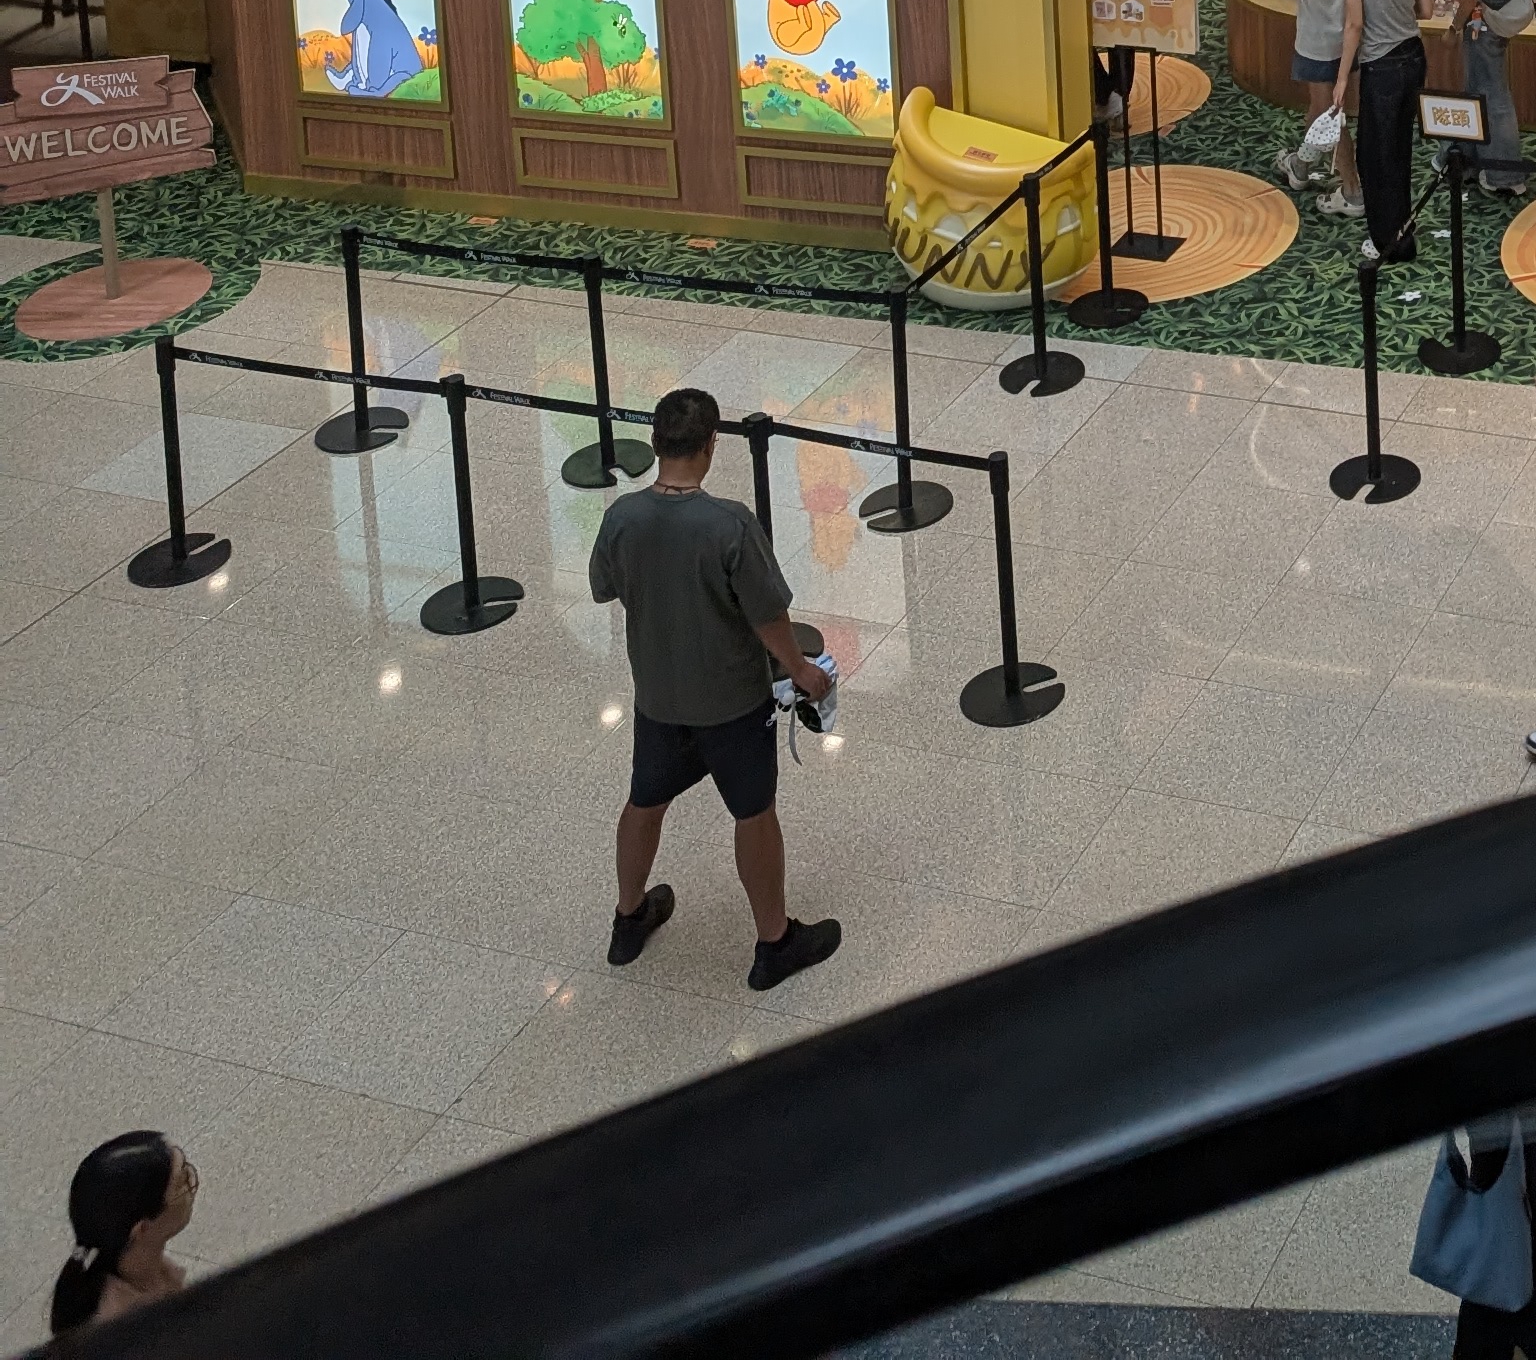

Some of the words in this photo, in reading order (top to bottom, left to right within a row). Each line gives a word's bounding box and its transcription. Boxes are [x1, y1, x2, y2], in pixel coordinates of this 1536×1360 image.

[83, 71, 138, 88] FESTIVAL
[100, 84, 139, 100] WALK
[1431, 105, 1471, 129] 隊頭
[3, 116, 193, 163] WELCOME
